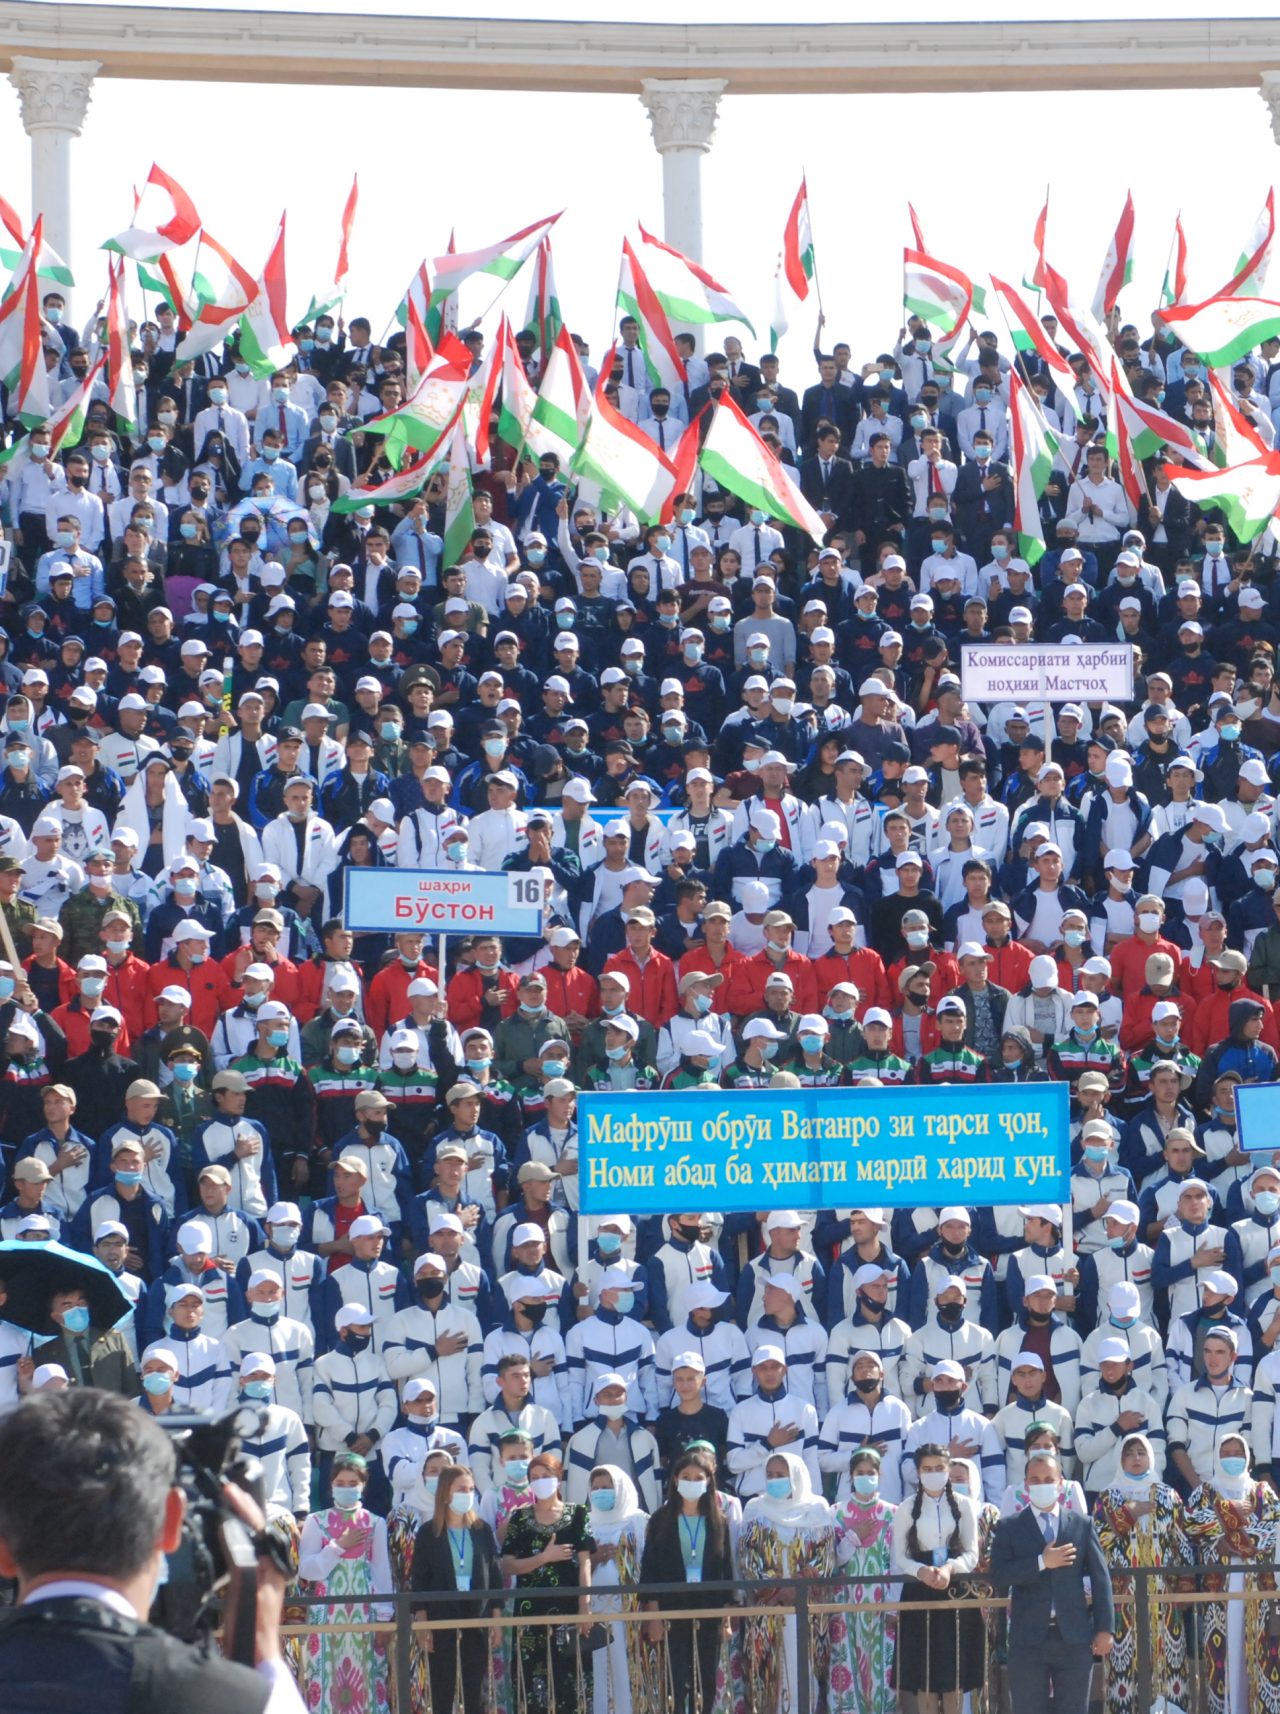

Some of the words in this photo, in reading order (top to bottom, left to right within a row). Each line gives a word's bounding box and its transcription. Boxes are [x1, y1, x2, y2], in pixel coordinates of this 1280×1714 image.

[967, 651, 1070, 671] Комиссариати
[1076, 650, 1128, 670] ҳарбии
[988, 679, 1039, 694] ноҳияи
[1045, 675, 1108, 693] Мастчоҳ
[419, 880, 471, 894] шаҳри
[512, 878, 540, 903] 16
[395, 896, 494, 924] Бӯстон
[587, 1113, 693, 1152] Мафрӯш
[701, 1110, 772, 1150] обрӯи
[781, 1109, 881, 1147] Ватанро
[889, 1114, 915, 1137] зи
[923, 1113, 990, 1145] тарси
[998, 1112, 1049, 1142] ҷон,
[588, 1157, 655, 1188] Номи
[664, 1154, 717, 1188] абад
[725, 1153, 753, 1185] ба
[762, 1160, 847, 1190] ҳимати
[856, 1155, 928, 1190] мардӣ
[937, 1156, 1006, 1188] харид
[1014, 1155, 1062, 1186] кун.
